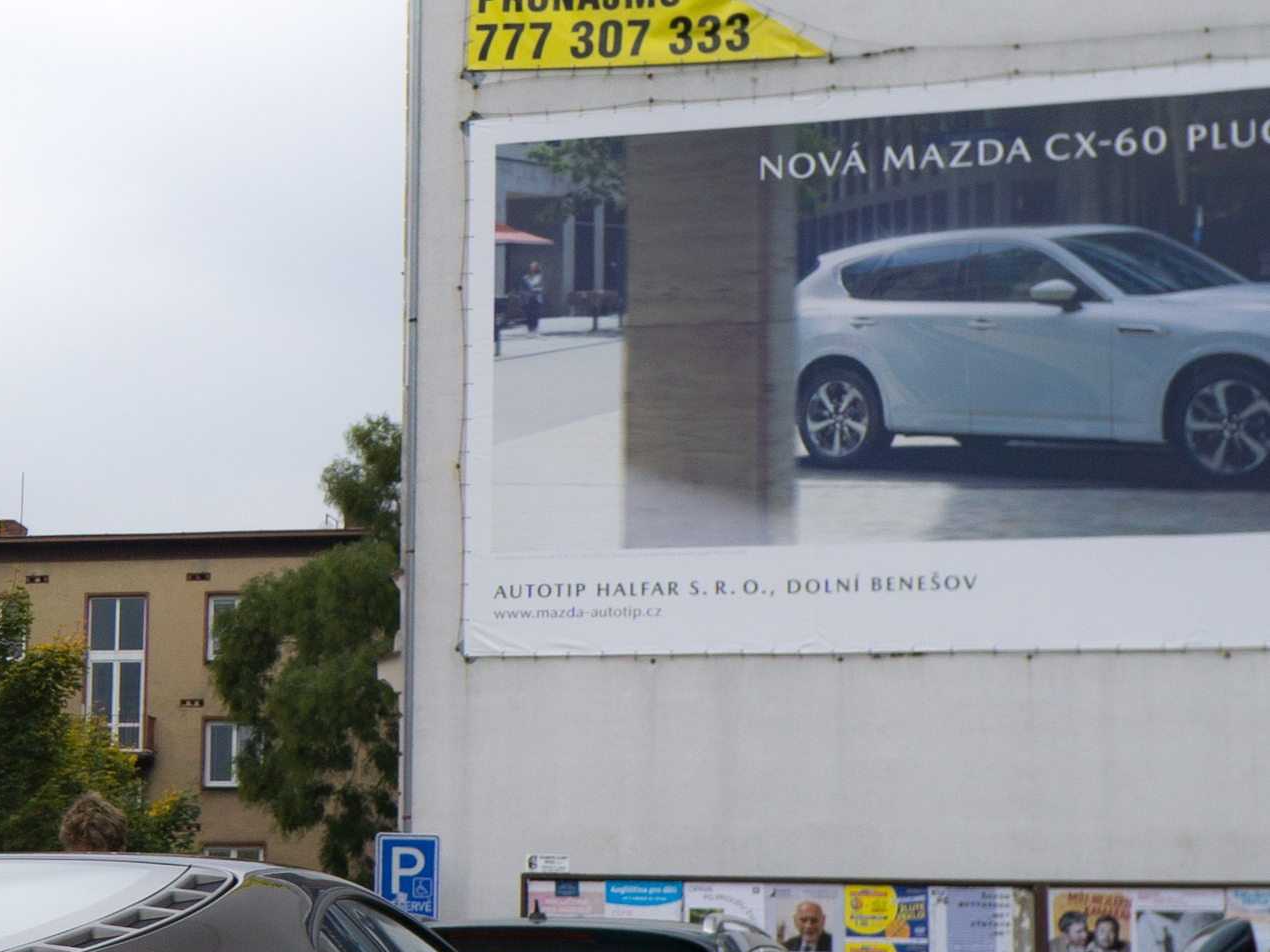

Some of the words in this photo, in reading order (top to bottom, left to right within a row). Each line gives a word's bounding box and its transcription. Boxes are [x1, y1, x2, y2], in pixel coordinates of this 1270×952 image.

[475, 22, 553, 61] 777
[570, 18, 651, 59] 307
[668, 13, 750, 55] 333
[760, 141, 867, 181] NOVÁ
[882, 137, 1032, 172] MAZDA
[1044, 126, 1168, 162] CX-60
[494, 583, 586, 599] AUTOTIP
[596, 581, 680, 597] HALFAR
[786, 574, 860, 594] DOLNÍ
[870, 571, 978, 592] BENEŠOV
[493, 606, 663, 620] www.mazda-autotip.cz
